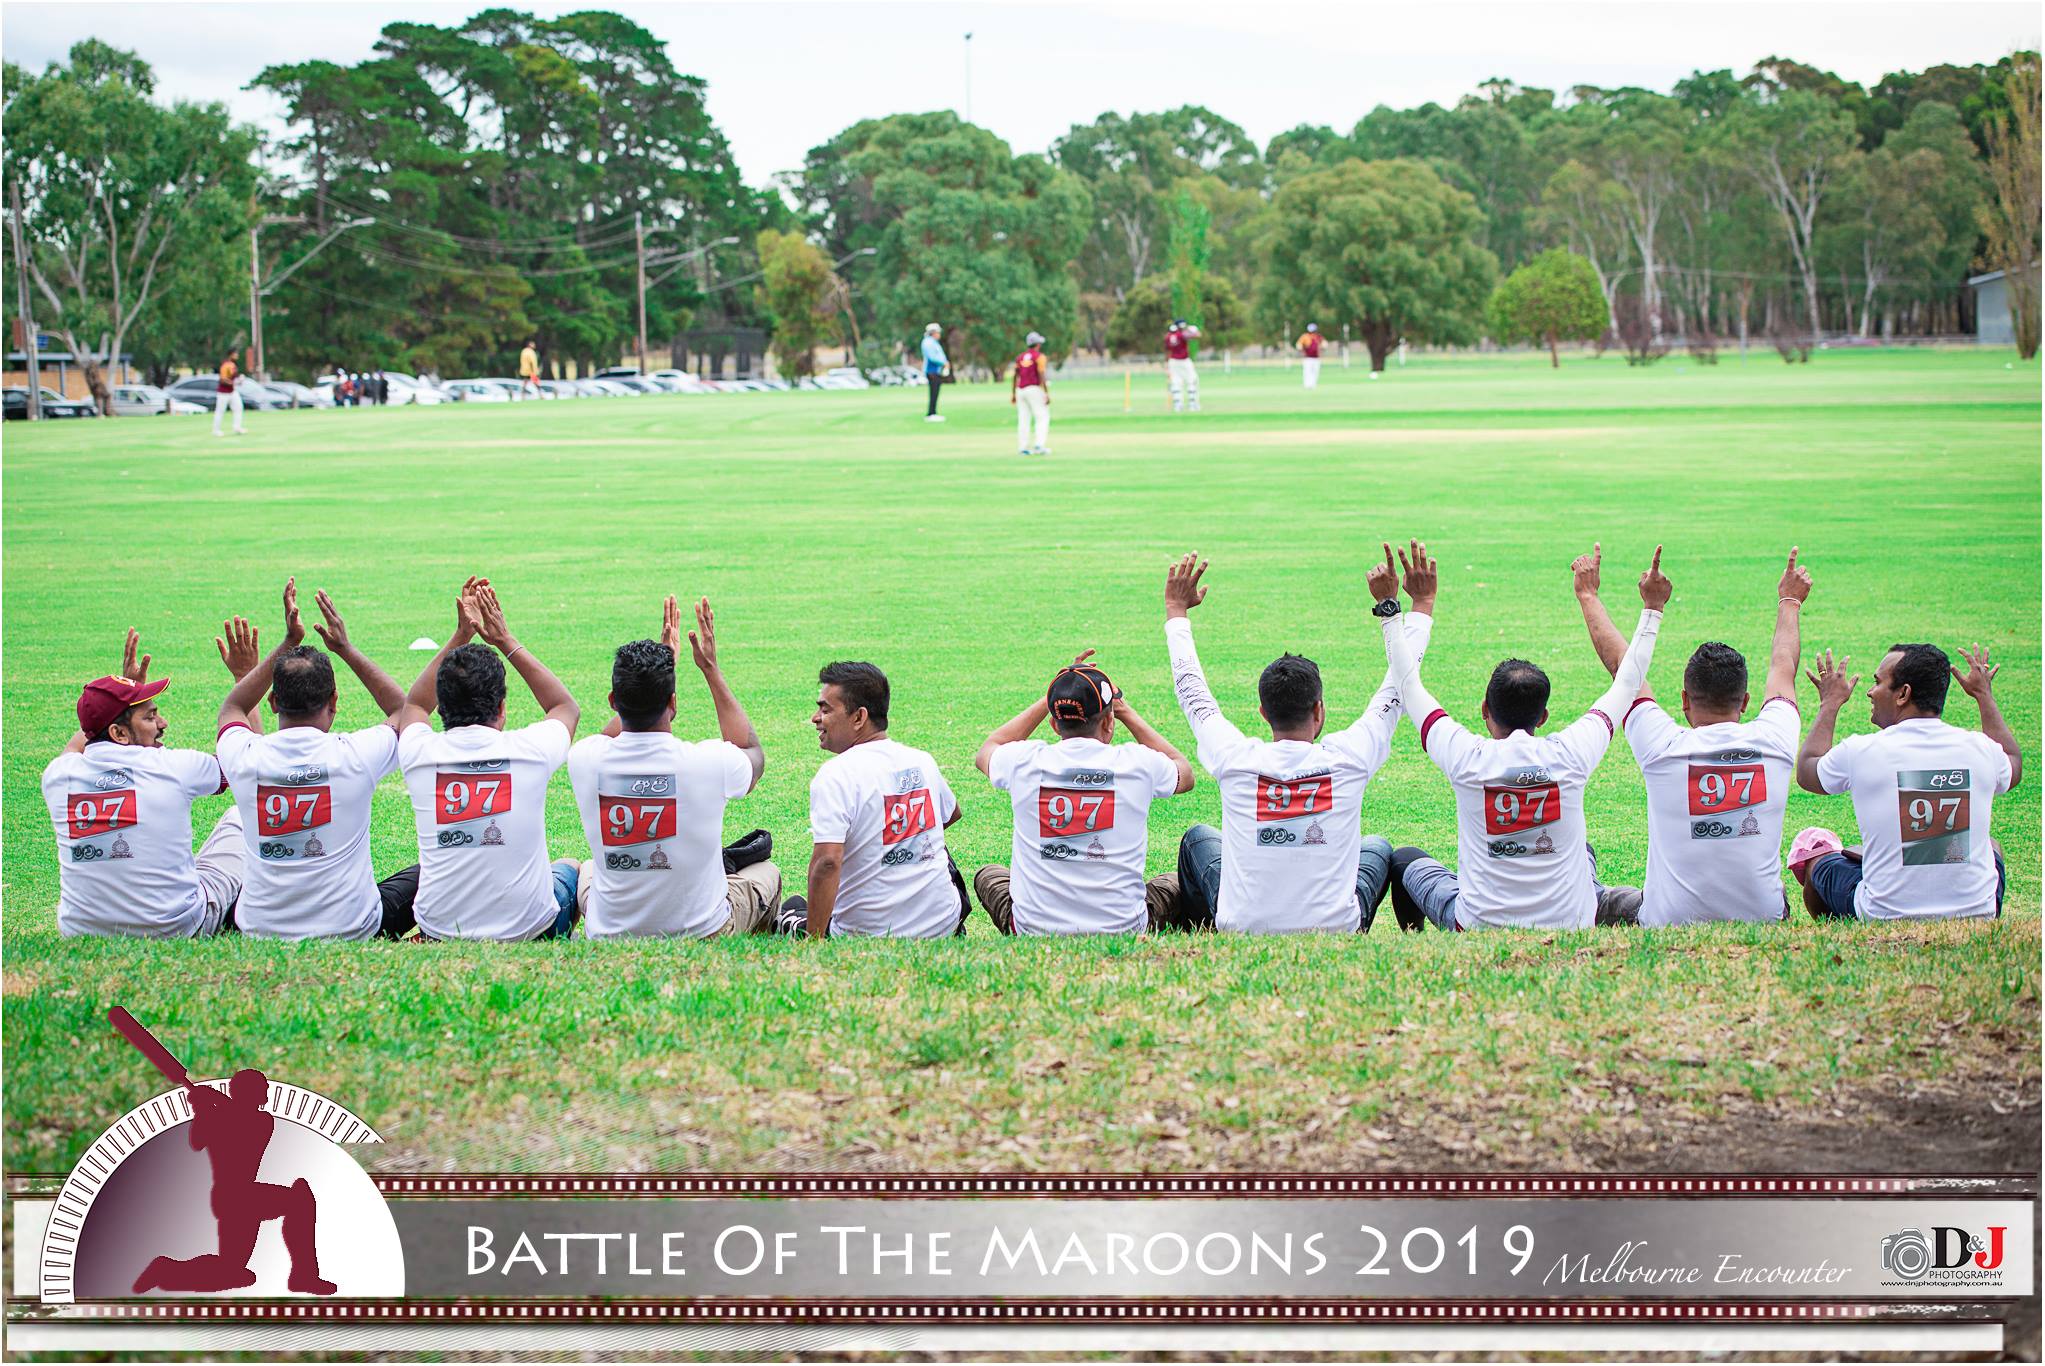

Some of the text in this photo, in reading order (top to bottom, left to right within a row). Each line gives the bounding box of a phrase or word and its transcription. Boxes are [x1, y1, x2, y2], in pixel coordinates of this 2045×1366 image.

[444, 780, 502, 815] 97
[1265, 782, 1321, 812] 97
[1698, 771, 1755, 805] 97
[75, 796, 126, 830] 97
[265, 794, 320, 828] 97
[608, 804, 666, 839] 97
[890, 796, 926, 835] 97
[1048, 795, 1105, 830] 97
[1495, 790, 1550, 826] 97
[1908, 797, 1961, 832] 97
